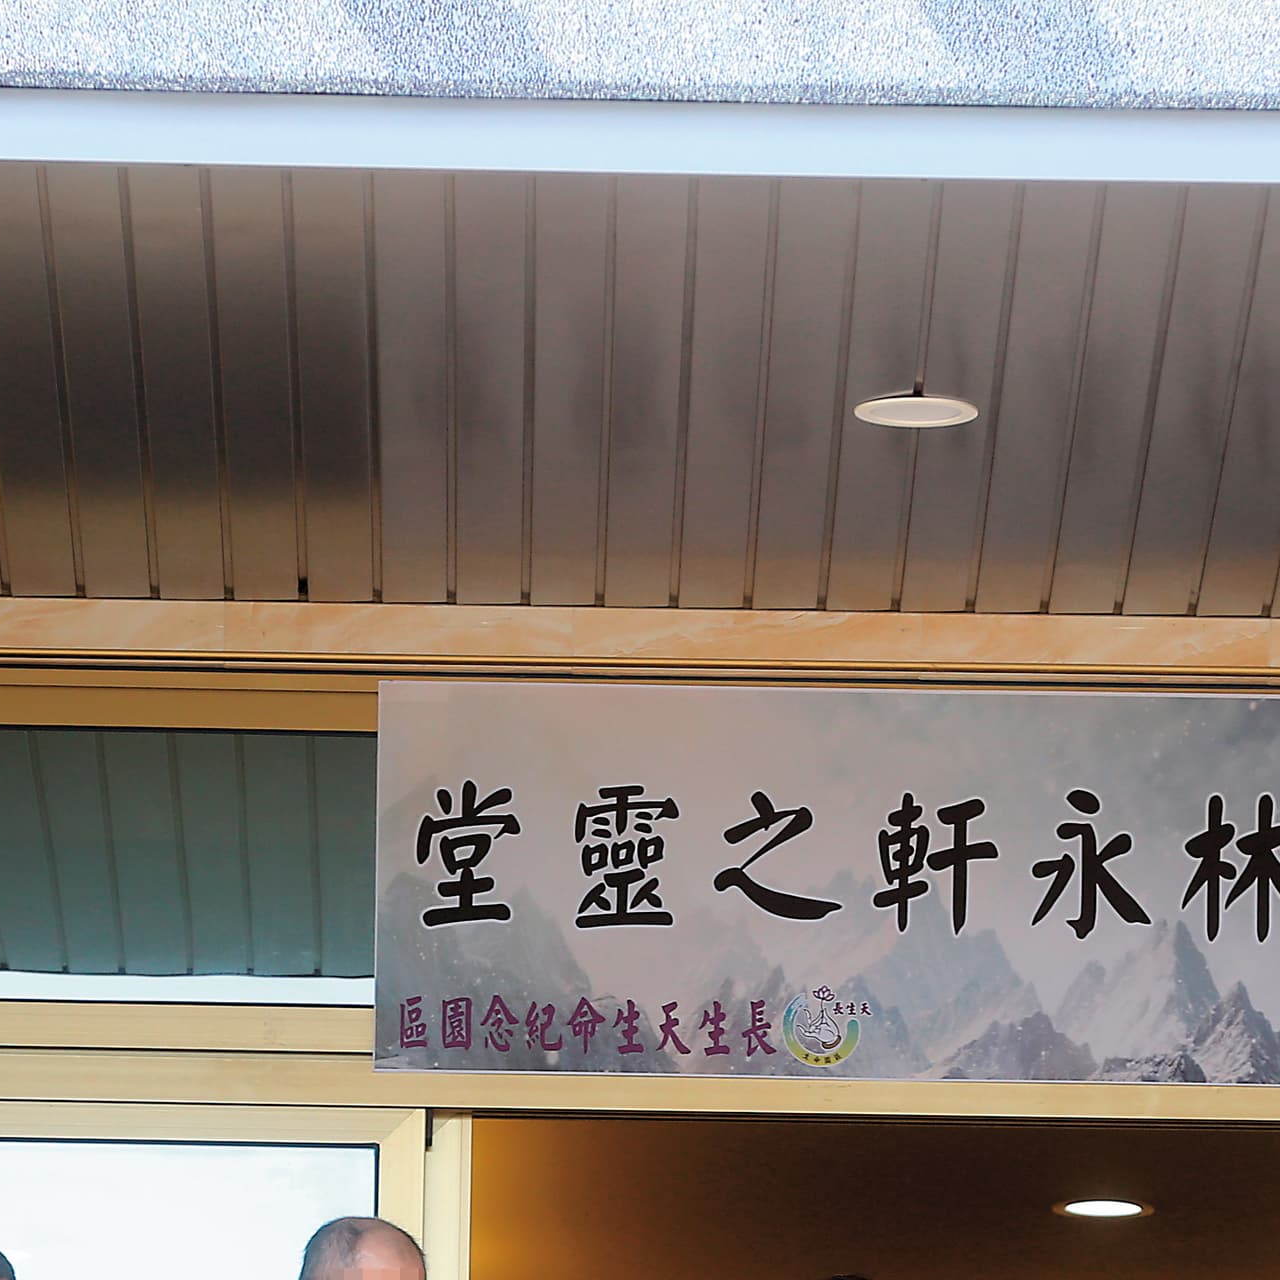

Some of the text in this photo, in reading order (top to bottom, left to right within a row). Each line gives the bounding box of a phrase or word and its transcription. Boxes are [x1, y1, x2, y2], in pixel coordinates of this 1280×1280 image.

[399, 994, 778, 1057] 長生天生命紀念園區
